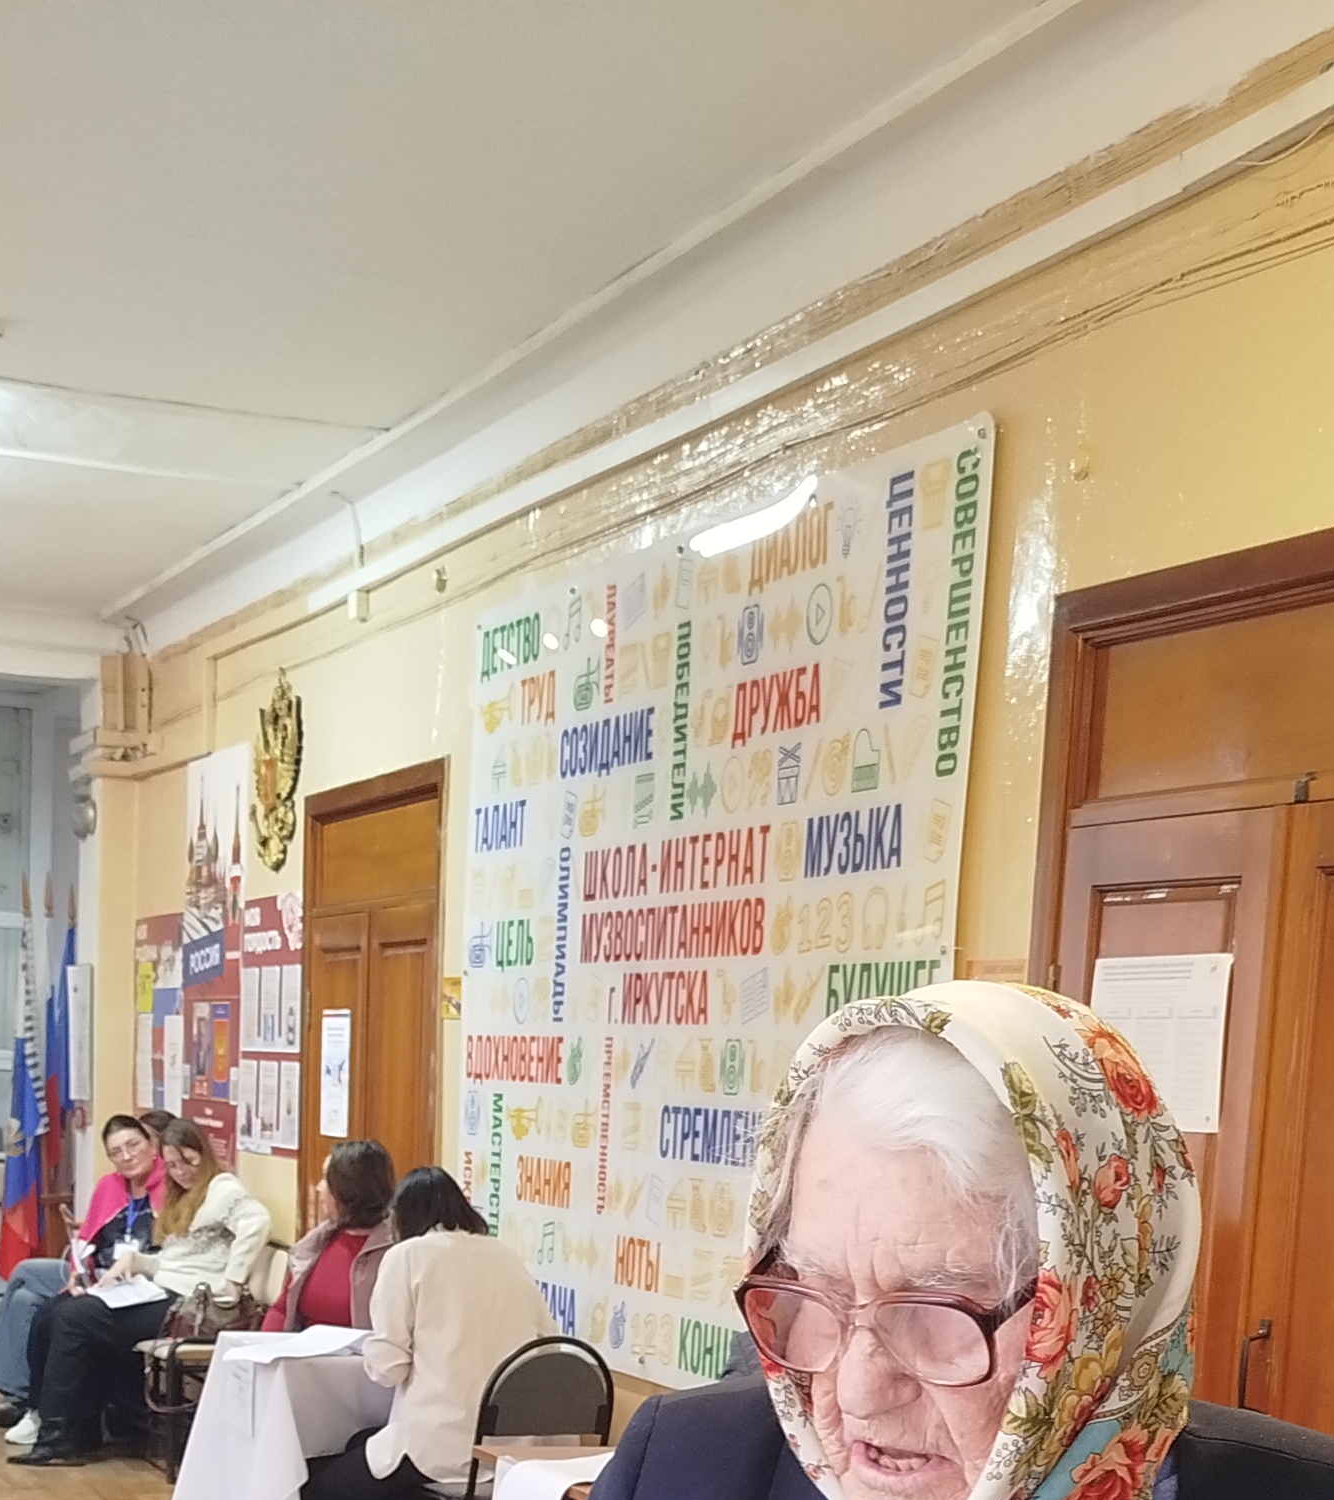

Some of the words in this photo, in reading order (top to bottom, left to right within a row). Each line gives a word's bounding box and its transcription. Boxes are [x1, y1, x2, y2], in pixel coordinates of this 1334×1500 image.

[748, 500, 835, 597] ДИАЛОГ
[878, 470, 915, 711] ЦЕННОСТИ
[934, 447, 982, 779] СОВЕРШЕНСТВО
[480, 611, 541, 684] ДЕТСТВО
[603, 584, 617, 705] ЛАУРЕАТЫ
[521, 670, 556, 726] ТРУД
[670, 620, 692, 822] ПОБЕДИТЕЛИ
[731, 662, 821, 750] ДРУЖБА
[559, 706, 655, 779] СОЗИДАНИЕ
[475, 799, 527, 854] ТАЛАНТ
[583, 824, 771, 902] ШКОЛА-ИНТЕРНАТ
[804, 803, 903, 879] МУЗЫКА
[495, 918, 534, 974] ЦЕЛЬ
[552, 846, 572, 1023] ОЛИМПИАДЫ
[579, 897, 766, 964] МУЗВОСПИТАННИКОВ
[621, 969, 709, 1026] ИРКУТСКА
[466, 1034, 564, 1085] ВДОХНОВЕНИЕ
[596, 1036, 614, 1216] ПРЕЕМСТВЕННОСТЬ
[658, 1104, 763, 1169] СТРЕМЛЕН
[487, 1092, 504, 1238] МАСТЕРСТВ
[516, 1155, 572, 1209] ЗНАНИЯ
[614, 1234, 662, 1293] НОТЫ
[535, 1279, 576, 1337] АЧА
[678, 1317, 741, 1381] КОНЦ
